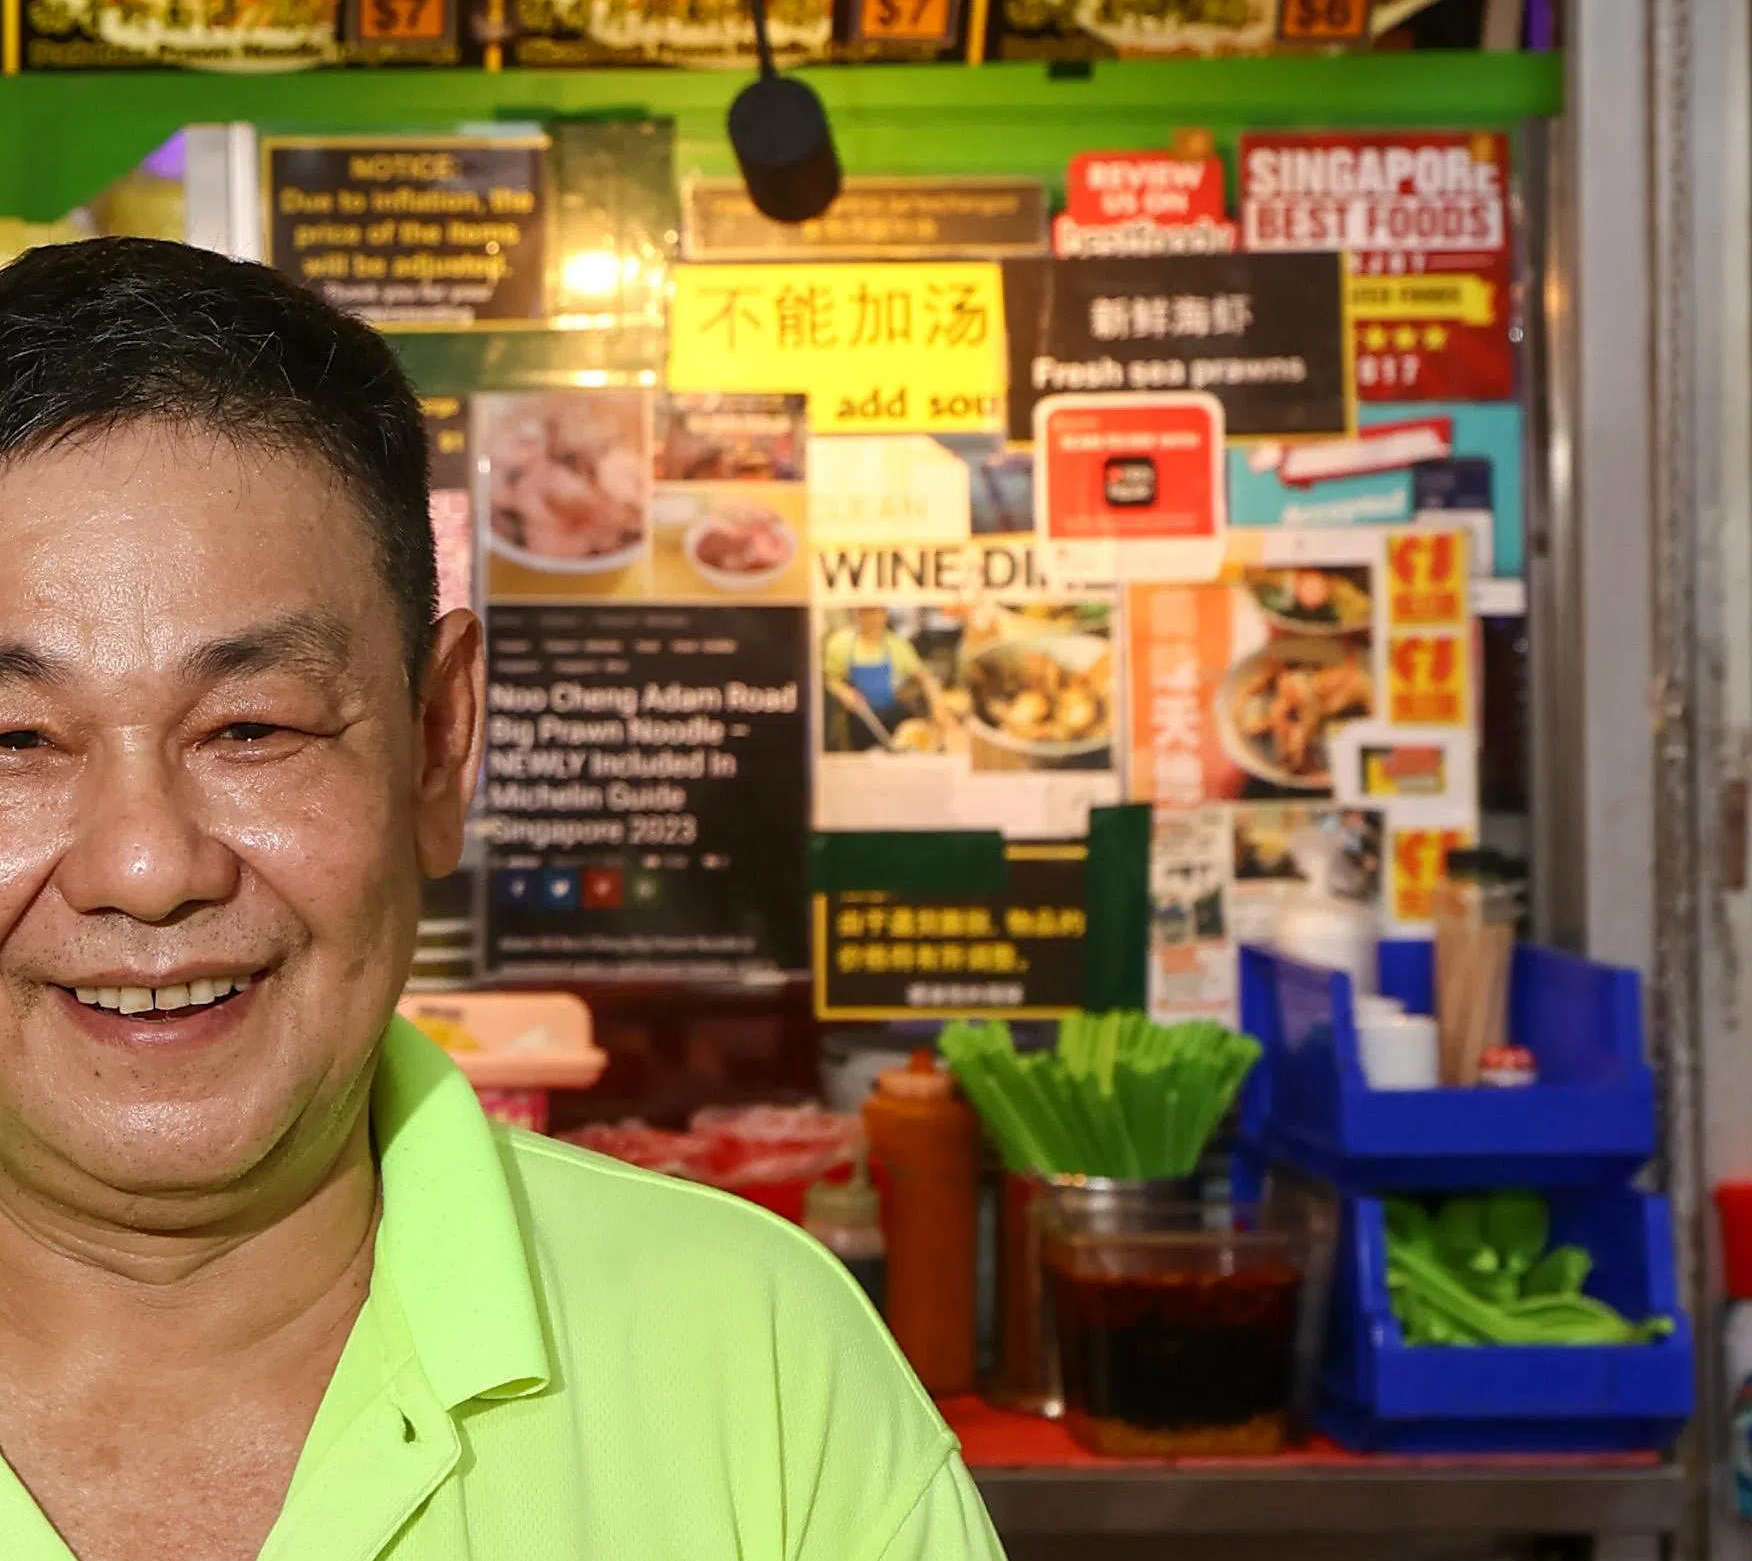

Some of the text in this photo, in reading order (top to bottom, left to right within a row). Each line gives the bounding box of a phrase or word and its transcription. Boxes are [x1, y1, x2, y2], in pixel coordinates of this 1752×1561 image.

[1086, 160, 1205, 191] REVIEW
[280, 186, 334, 214] Due
[337, 187, 367, 214] to
[489, 186, 535, 214] the
[398, 218, 443, 246] the
[1257, 202, 1494, 240] BEST FOODS
[699, 281, 989, 350] 不能加汤
[1031, 355, 1307, 389] Fresh sea prawns
[836, 386, 908, 420] add
[818, 547, 962, 589] WINE
[549, 681, 638, 717] Cheng
[641, 681, 723, 713] Adam
[724, 681, 797, 713] Road
[537, 714, 624, 745] Prawn
[626, 713, 725, 746] Noodle
[488, 780, 687, 811] Michelin Guide
